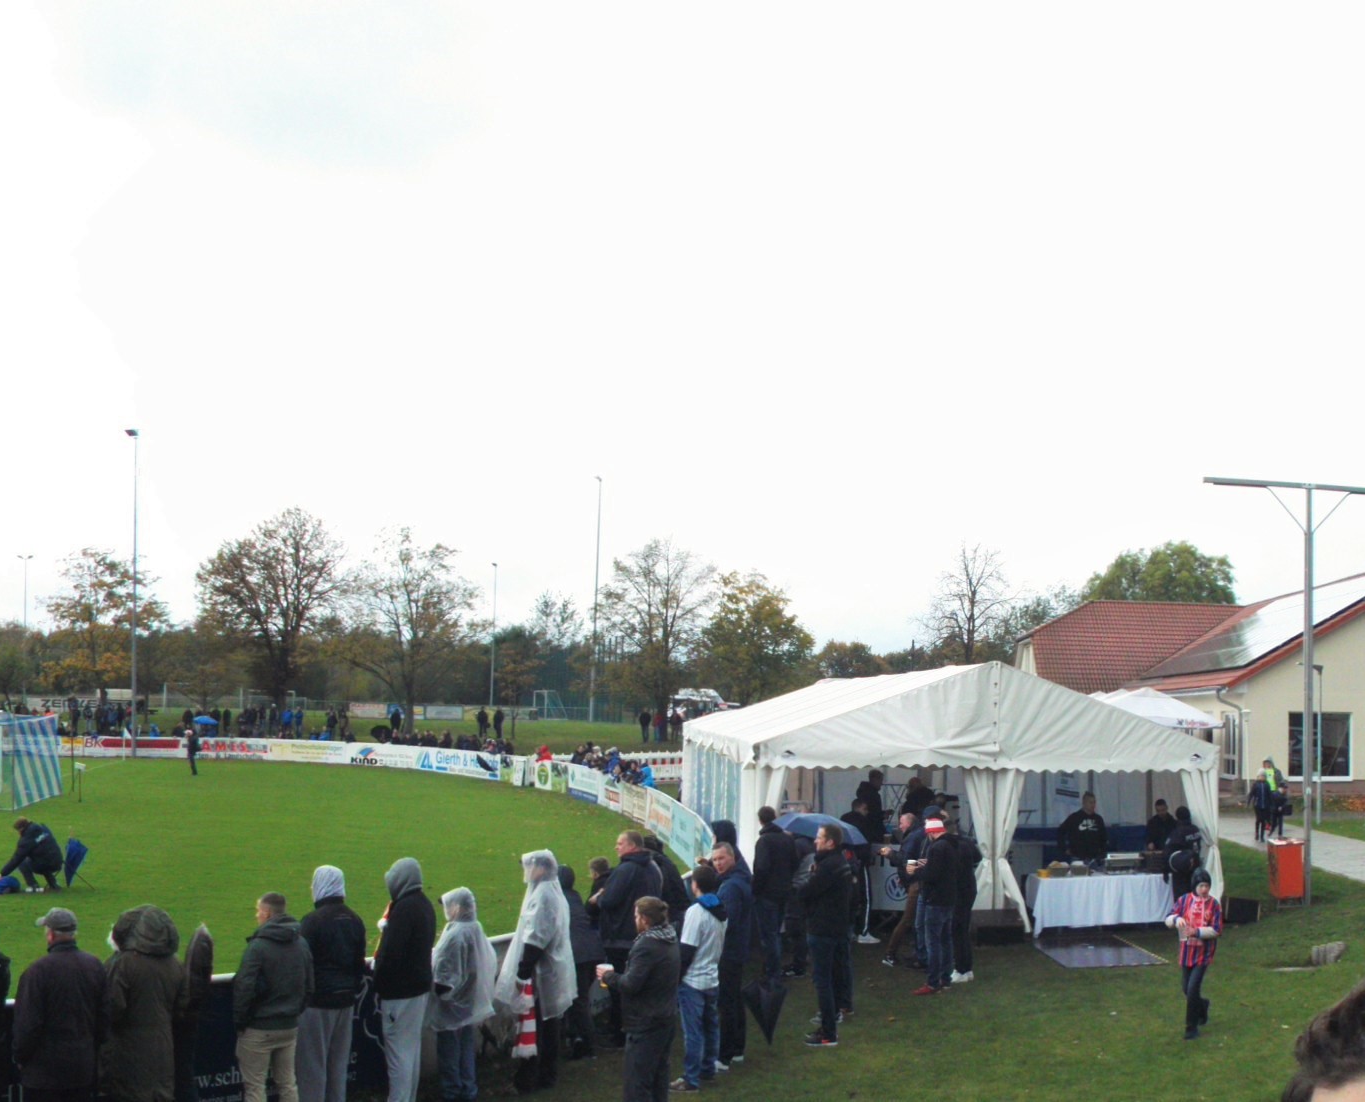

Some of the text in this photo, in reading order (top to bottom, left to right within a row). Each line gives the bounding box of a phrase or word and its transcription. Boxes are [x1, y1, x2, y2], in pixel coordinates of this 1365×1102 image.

[85, 738, 102, 748] BK
[350, 756, 378, 765] KIND
[435, 750, 461, 765] Gierth
